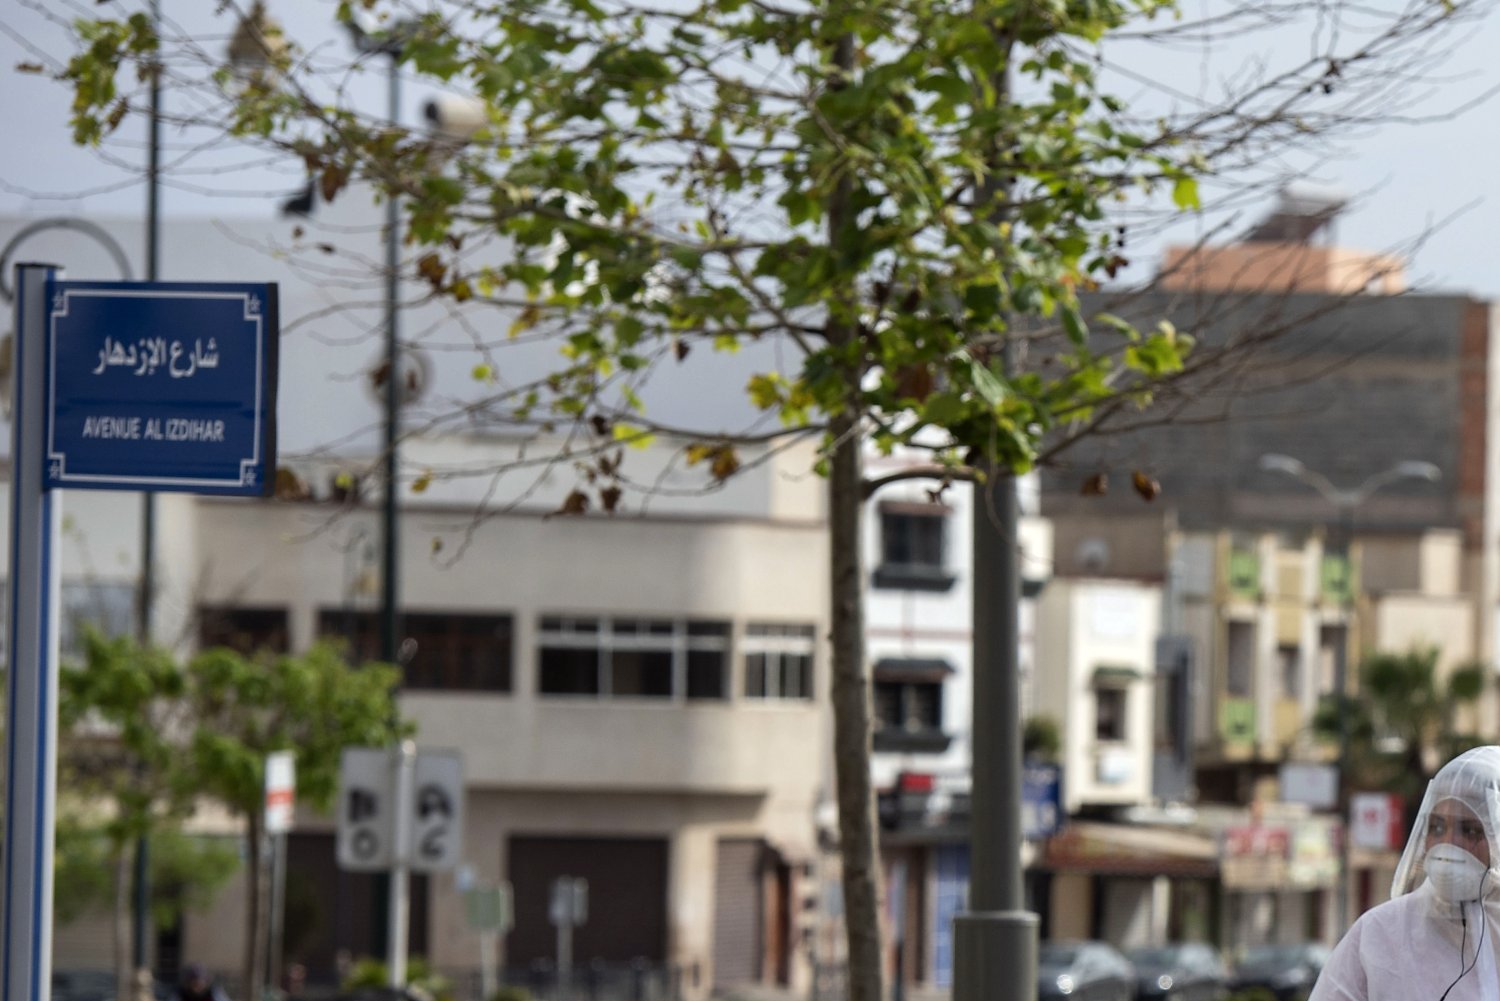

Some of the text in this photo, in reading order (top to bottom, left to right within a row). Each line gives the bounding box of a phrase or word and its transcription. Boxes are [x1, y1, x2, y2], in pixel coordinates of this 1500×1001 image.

[168, 338, 219, 378] شارع
[82, 416, 225, 442] AVENUE AL IZDIHAR
